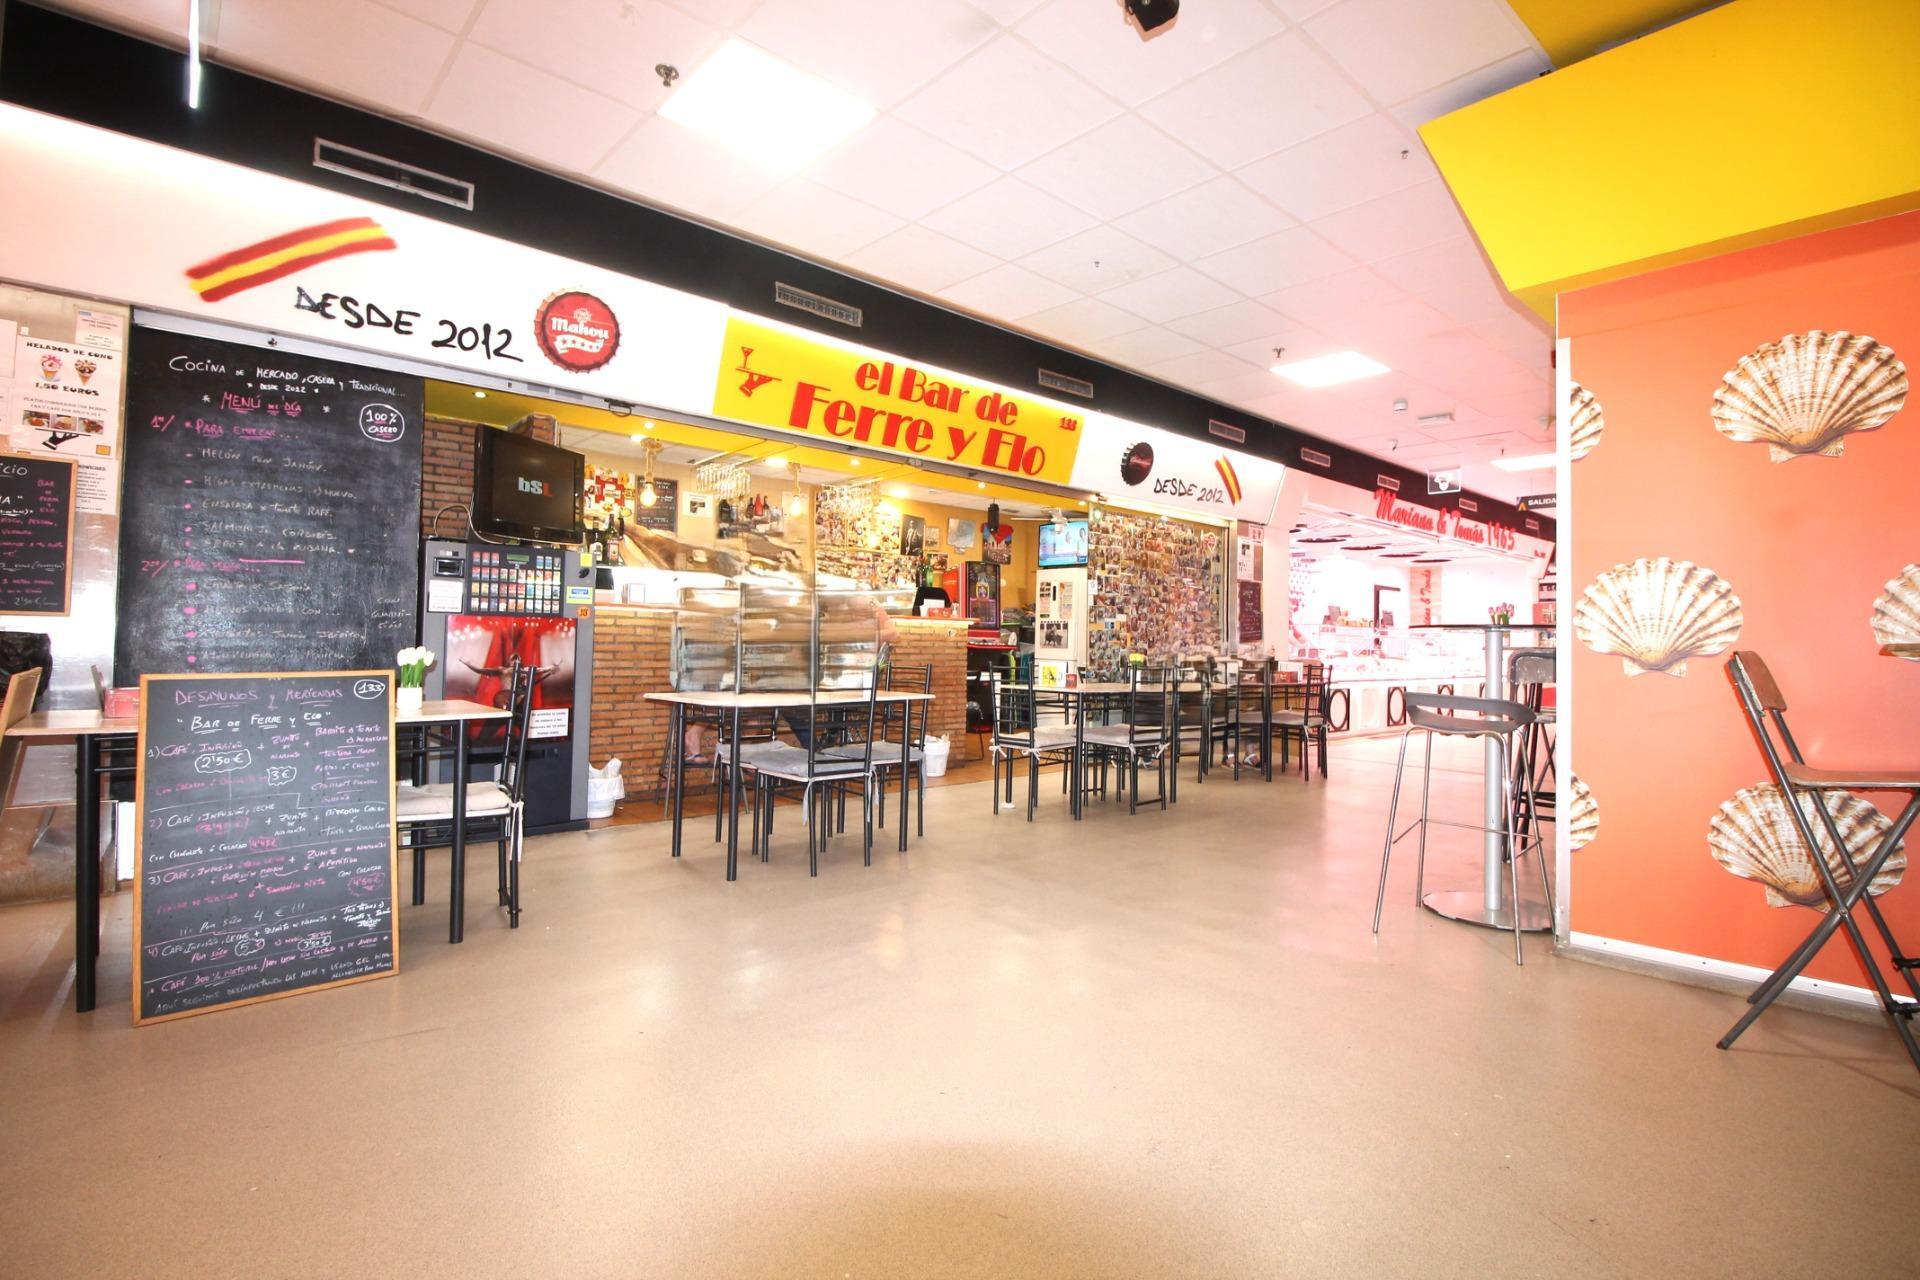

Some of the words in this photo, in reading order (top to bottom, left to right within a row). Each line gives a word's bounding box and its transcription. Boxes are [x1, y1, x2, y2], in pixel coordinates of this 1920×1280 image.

[294, 286, 422, 335] DESDE
[431, 319, 524, 362] 2012
[551, 317, 609, 339] Mahou
[26, 341, 70, 353] HELADOS
[87, 351, 113, 360] CONO
[169, 355, 226, 374] COCINA
[256, 367, 298, 380] MERCADO
[62, 386, 99, 397] EUROS
[284, 384, 307, 393] 2012
[855, 361, 893, 396] el
[899, 368, 970, 413] Bar
[975, 392, 1018, 425] de
[220, 391, 261, 410] MENÚ
[789, 382, 934, 453] Ferre
[947, 425, 978, 460] y
[981, 428, 1045, 476] Elo
[1153, 477, 1198, 497] DESDE
[1197, 487, 1224, 503] 2012
[1527, 497, 1557, 506] SALIDA
[1374, 488, 1434, 531] Mariano
[1487, 521, 1517, 551] 1965
[175, 689, 258, 706] DESAYUNOS
[285, 688, 343, 702] MERIENDAS
[191, 716, 220, 731] BAR
[250, 713, 282, 725] FERRE
[254, 910, 264, 921] 4
